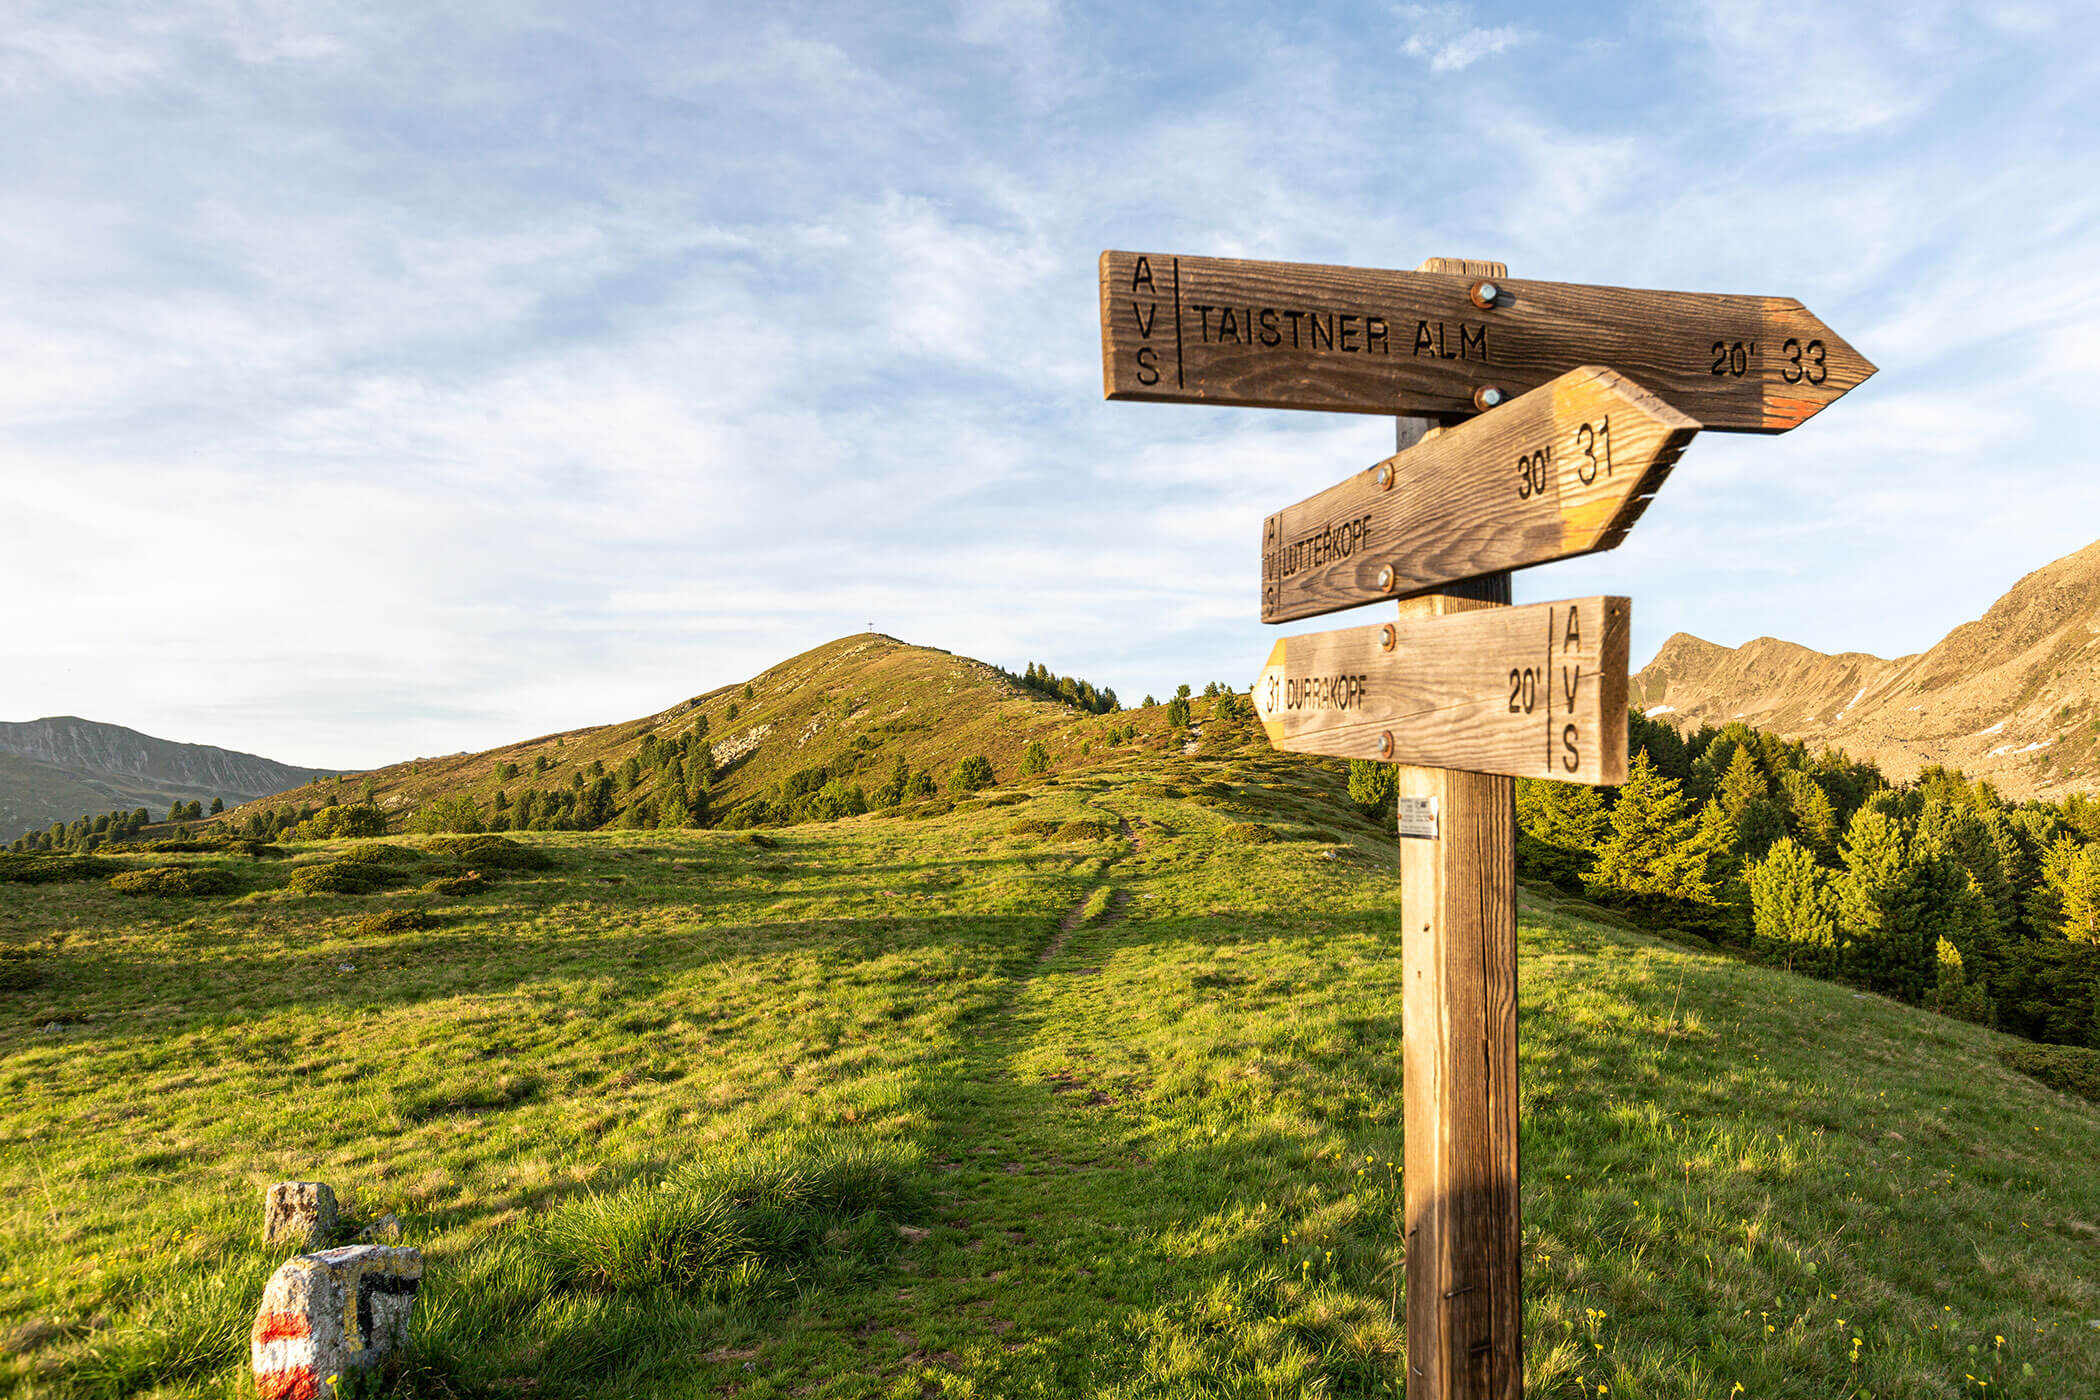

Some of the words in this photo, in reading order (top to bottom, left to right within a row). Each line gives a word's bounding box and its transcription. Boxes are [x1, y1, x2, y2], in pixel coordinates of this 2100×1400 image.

[1192, 305, 1390, 355] TAISTNER
[1413, 320, 1488, 361] ALM
[1711, 341, 1756, 378] 20'
[1782, 338, 1828, 386] 33
[1517, 445, 1551, 500] 30'
[1576, 414, 1613, 486] 31
[1282, 514, 1372, 577] LUTTERKOPF
[1266, 675, 1280, 713] 31
[1287, 674, 1367, 710] DURRAKOPF
[1509, 666, 1541, 715] 20'
